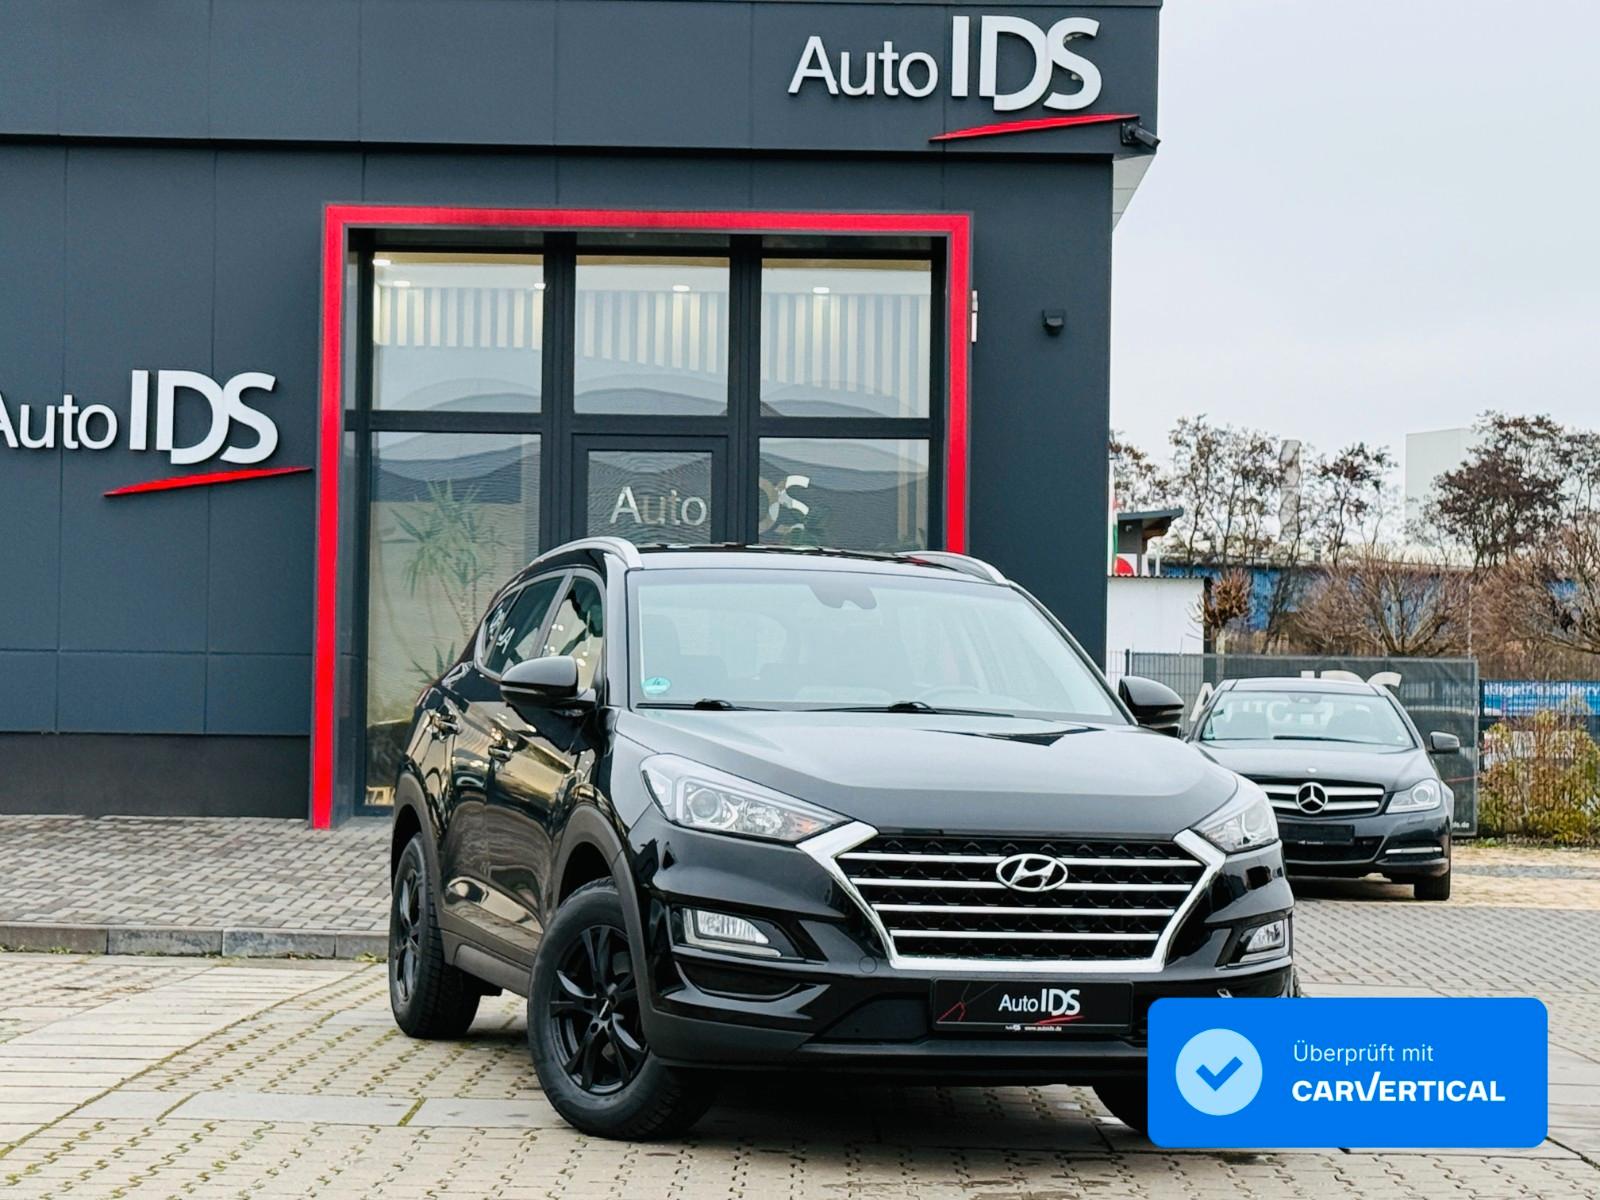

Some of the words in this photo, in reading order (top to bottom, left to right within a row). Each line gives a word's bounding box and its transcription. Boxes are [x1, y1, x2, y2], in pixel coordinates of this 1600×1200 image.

[787, 36, 938, 97] Auto
[951, 15, 1101, 111] IDS
[129, 369, 279, 464] IDS
[609, 486, 707, 526] Auto
[998, 994, 1038, 1013] Auto
[1040, 988, 1081, 1016] IDS
